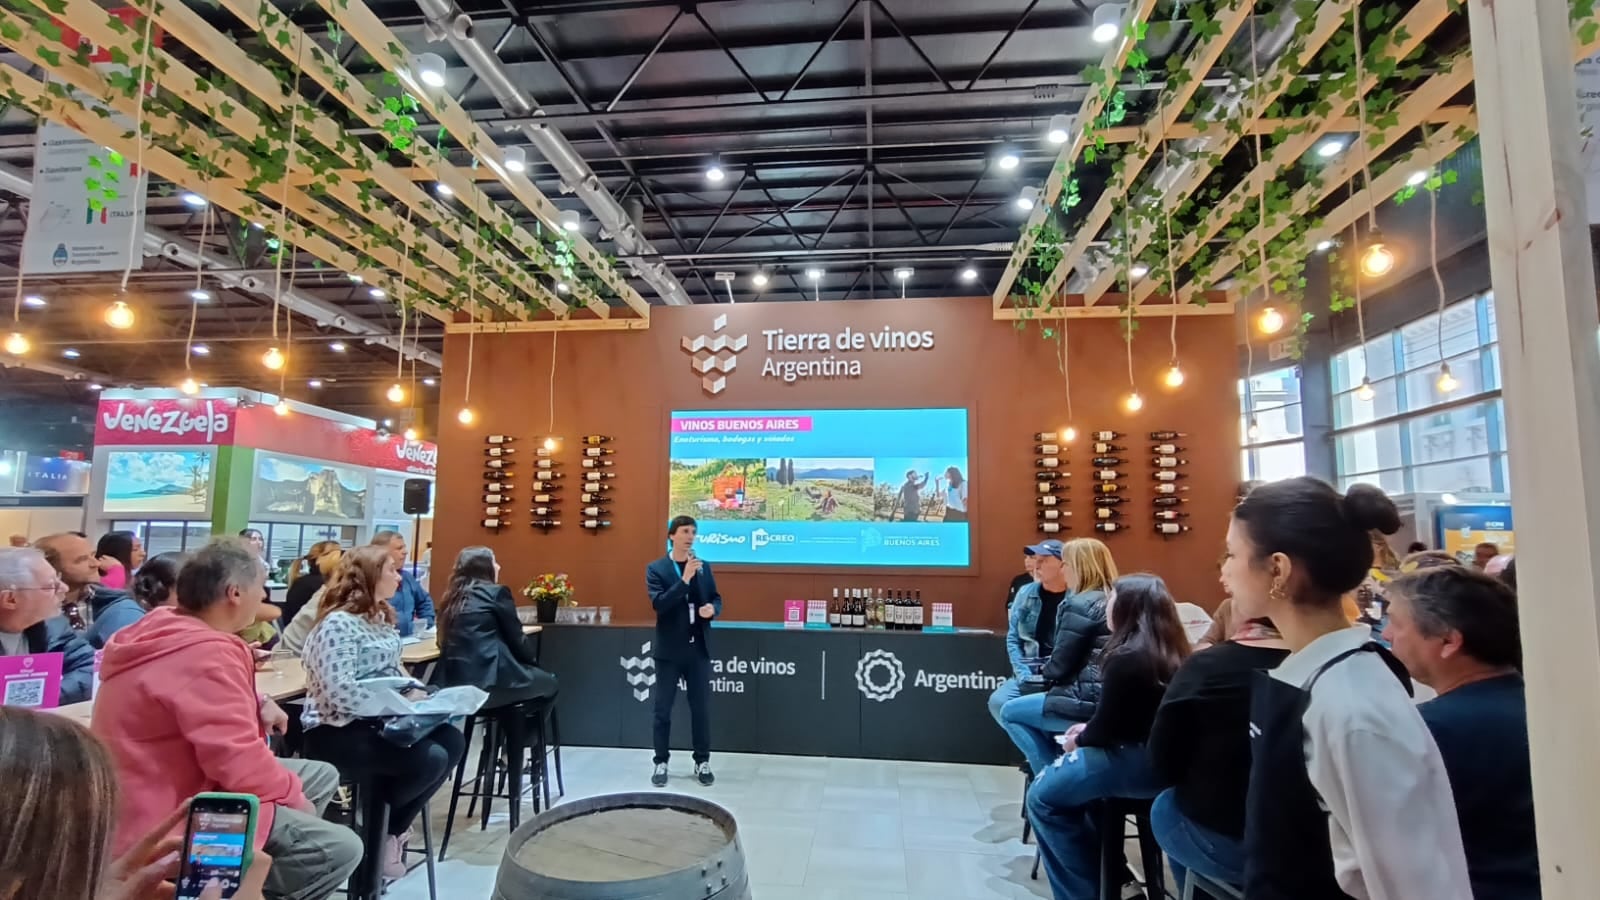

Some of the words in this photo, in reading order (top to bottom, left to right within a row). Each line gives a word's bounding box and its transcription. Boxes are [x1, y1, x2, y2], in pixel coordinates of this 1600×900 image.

[762, 328, 831, 351] Tierra
[836, 326, 865, 350] de
[869, 325, 934, 349] vinos
[761, 356, 862, 382] Argentina
[680, 420, 715, 431] VINOS
[717, 420, 764, 430] BUENOS
[766, 419, 800, 430] AIRES
[27, 471, 68, 480] ITALIA
[726, 656, 748, 673] de
[750, 656, 796, 675] vinos
